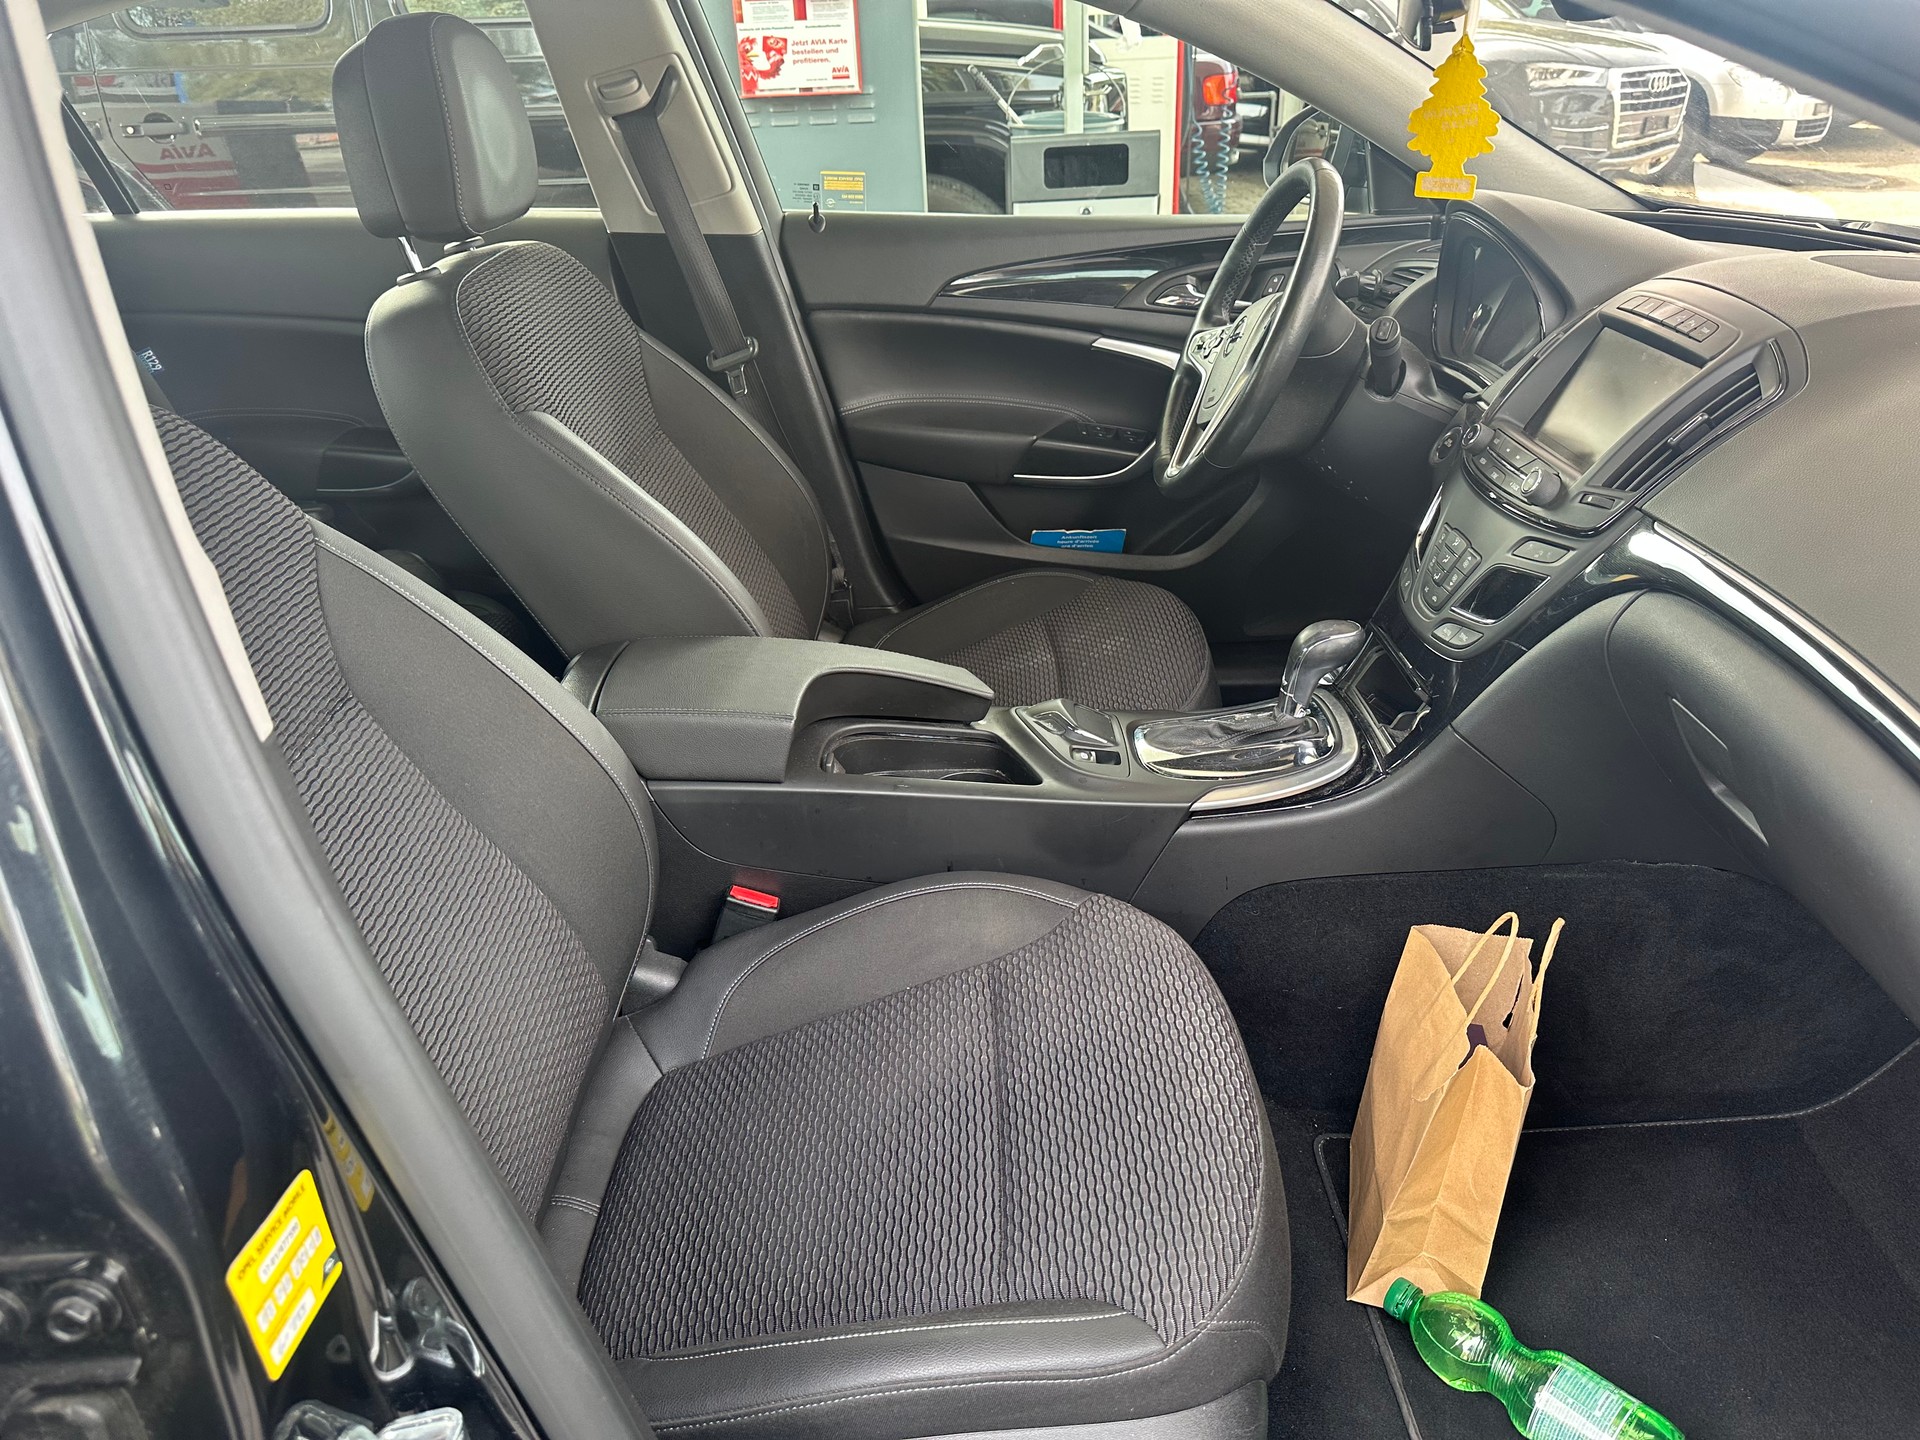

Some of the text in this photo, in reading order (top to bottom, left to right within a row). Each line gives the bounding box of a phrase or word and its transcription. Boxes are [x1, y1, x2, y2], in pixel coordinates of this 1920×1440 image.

[791, 39, 809, 47] Jetzt
[810, 38, 827, 46] AVIA
[791, 48, 824, 56] bestellen
[831, 65, 850, 74] AVIA
[141, 350, 162, 373] R129
[237, 1184, 306, 1281] OPEL SERVICE MOBILE
